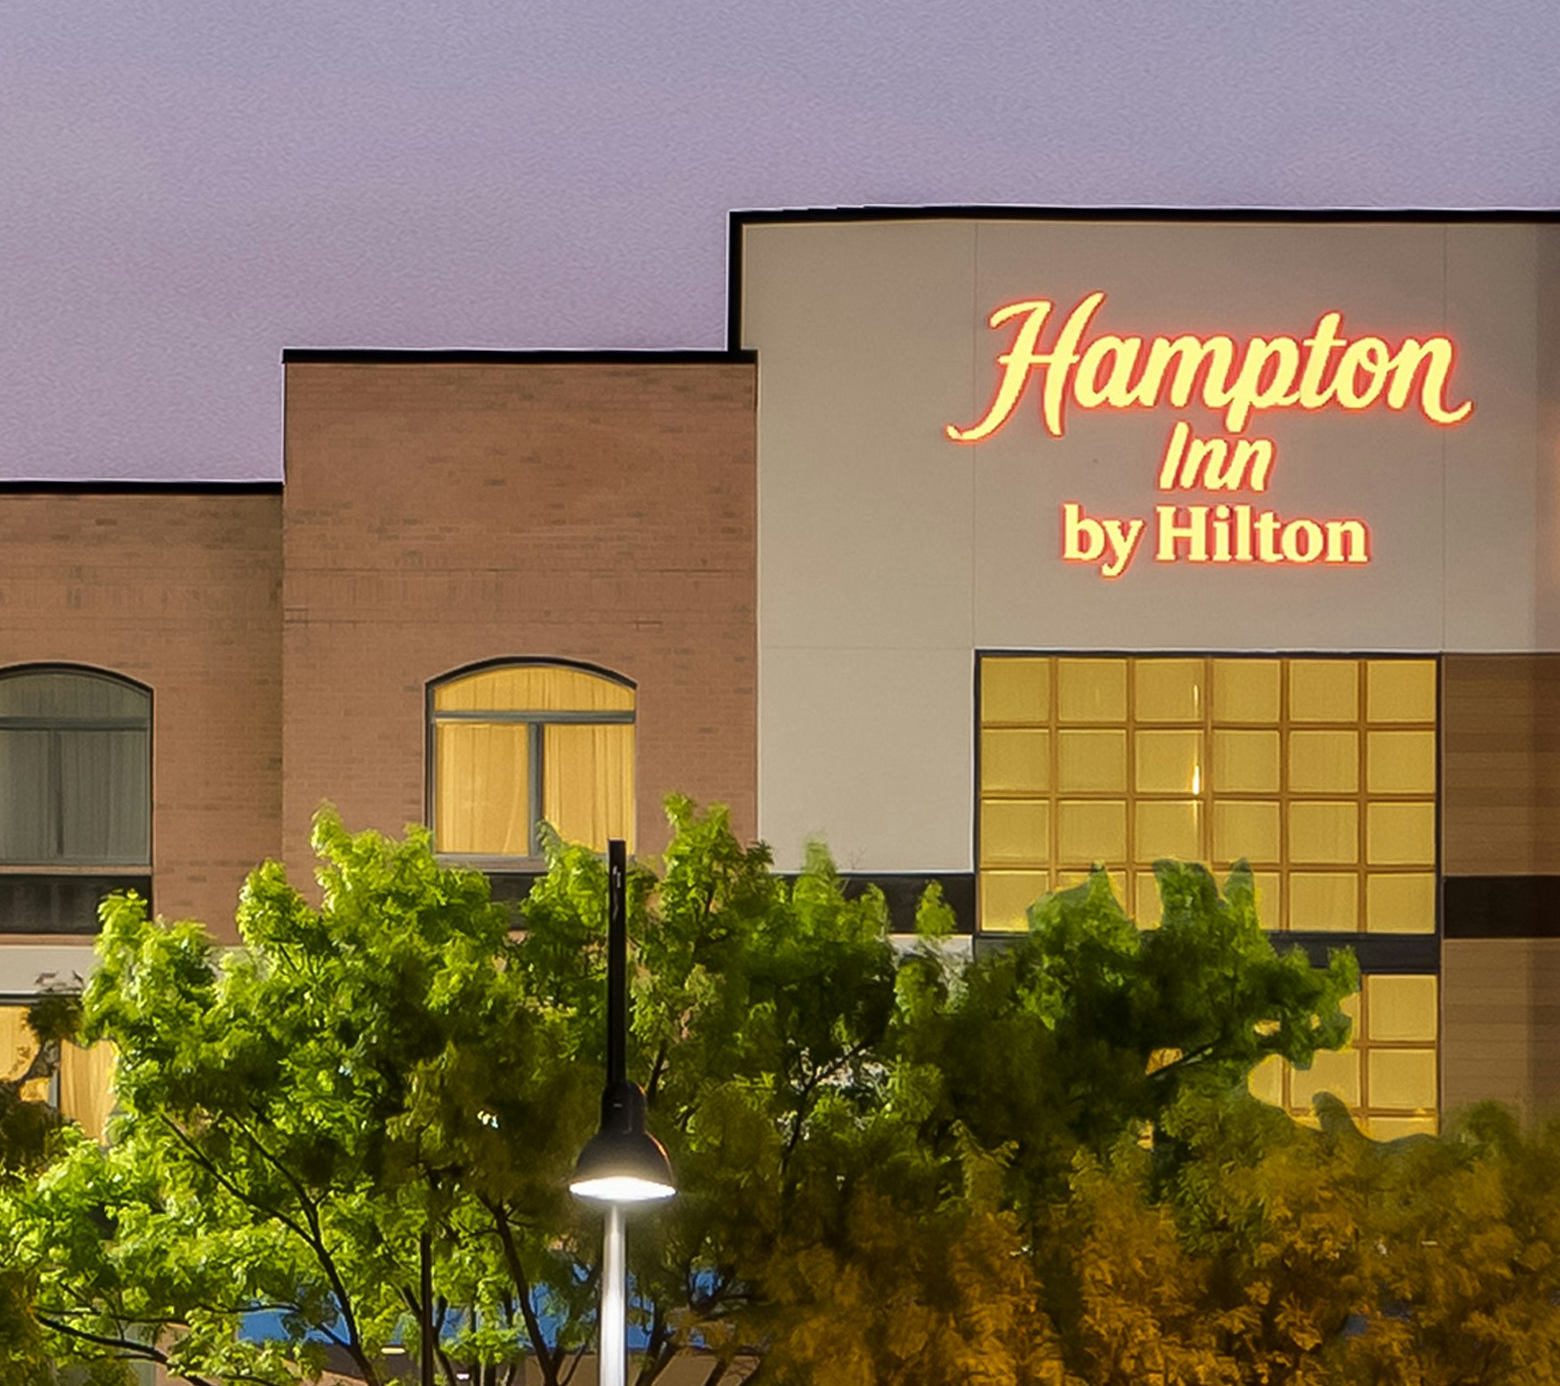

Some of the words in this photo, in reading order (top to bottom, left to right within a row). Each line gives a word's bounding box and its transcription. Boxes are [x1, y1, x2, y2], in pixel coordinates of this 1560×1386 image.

[946, 291, 1473, 441] Hampton
[1159, 420, 1274, 492] Inn
[1063, 503, 1144, 577] by
[1156, 504, 1369, 563] Hilton
